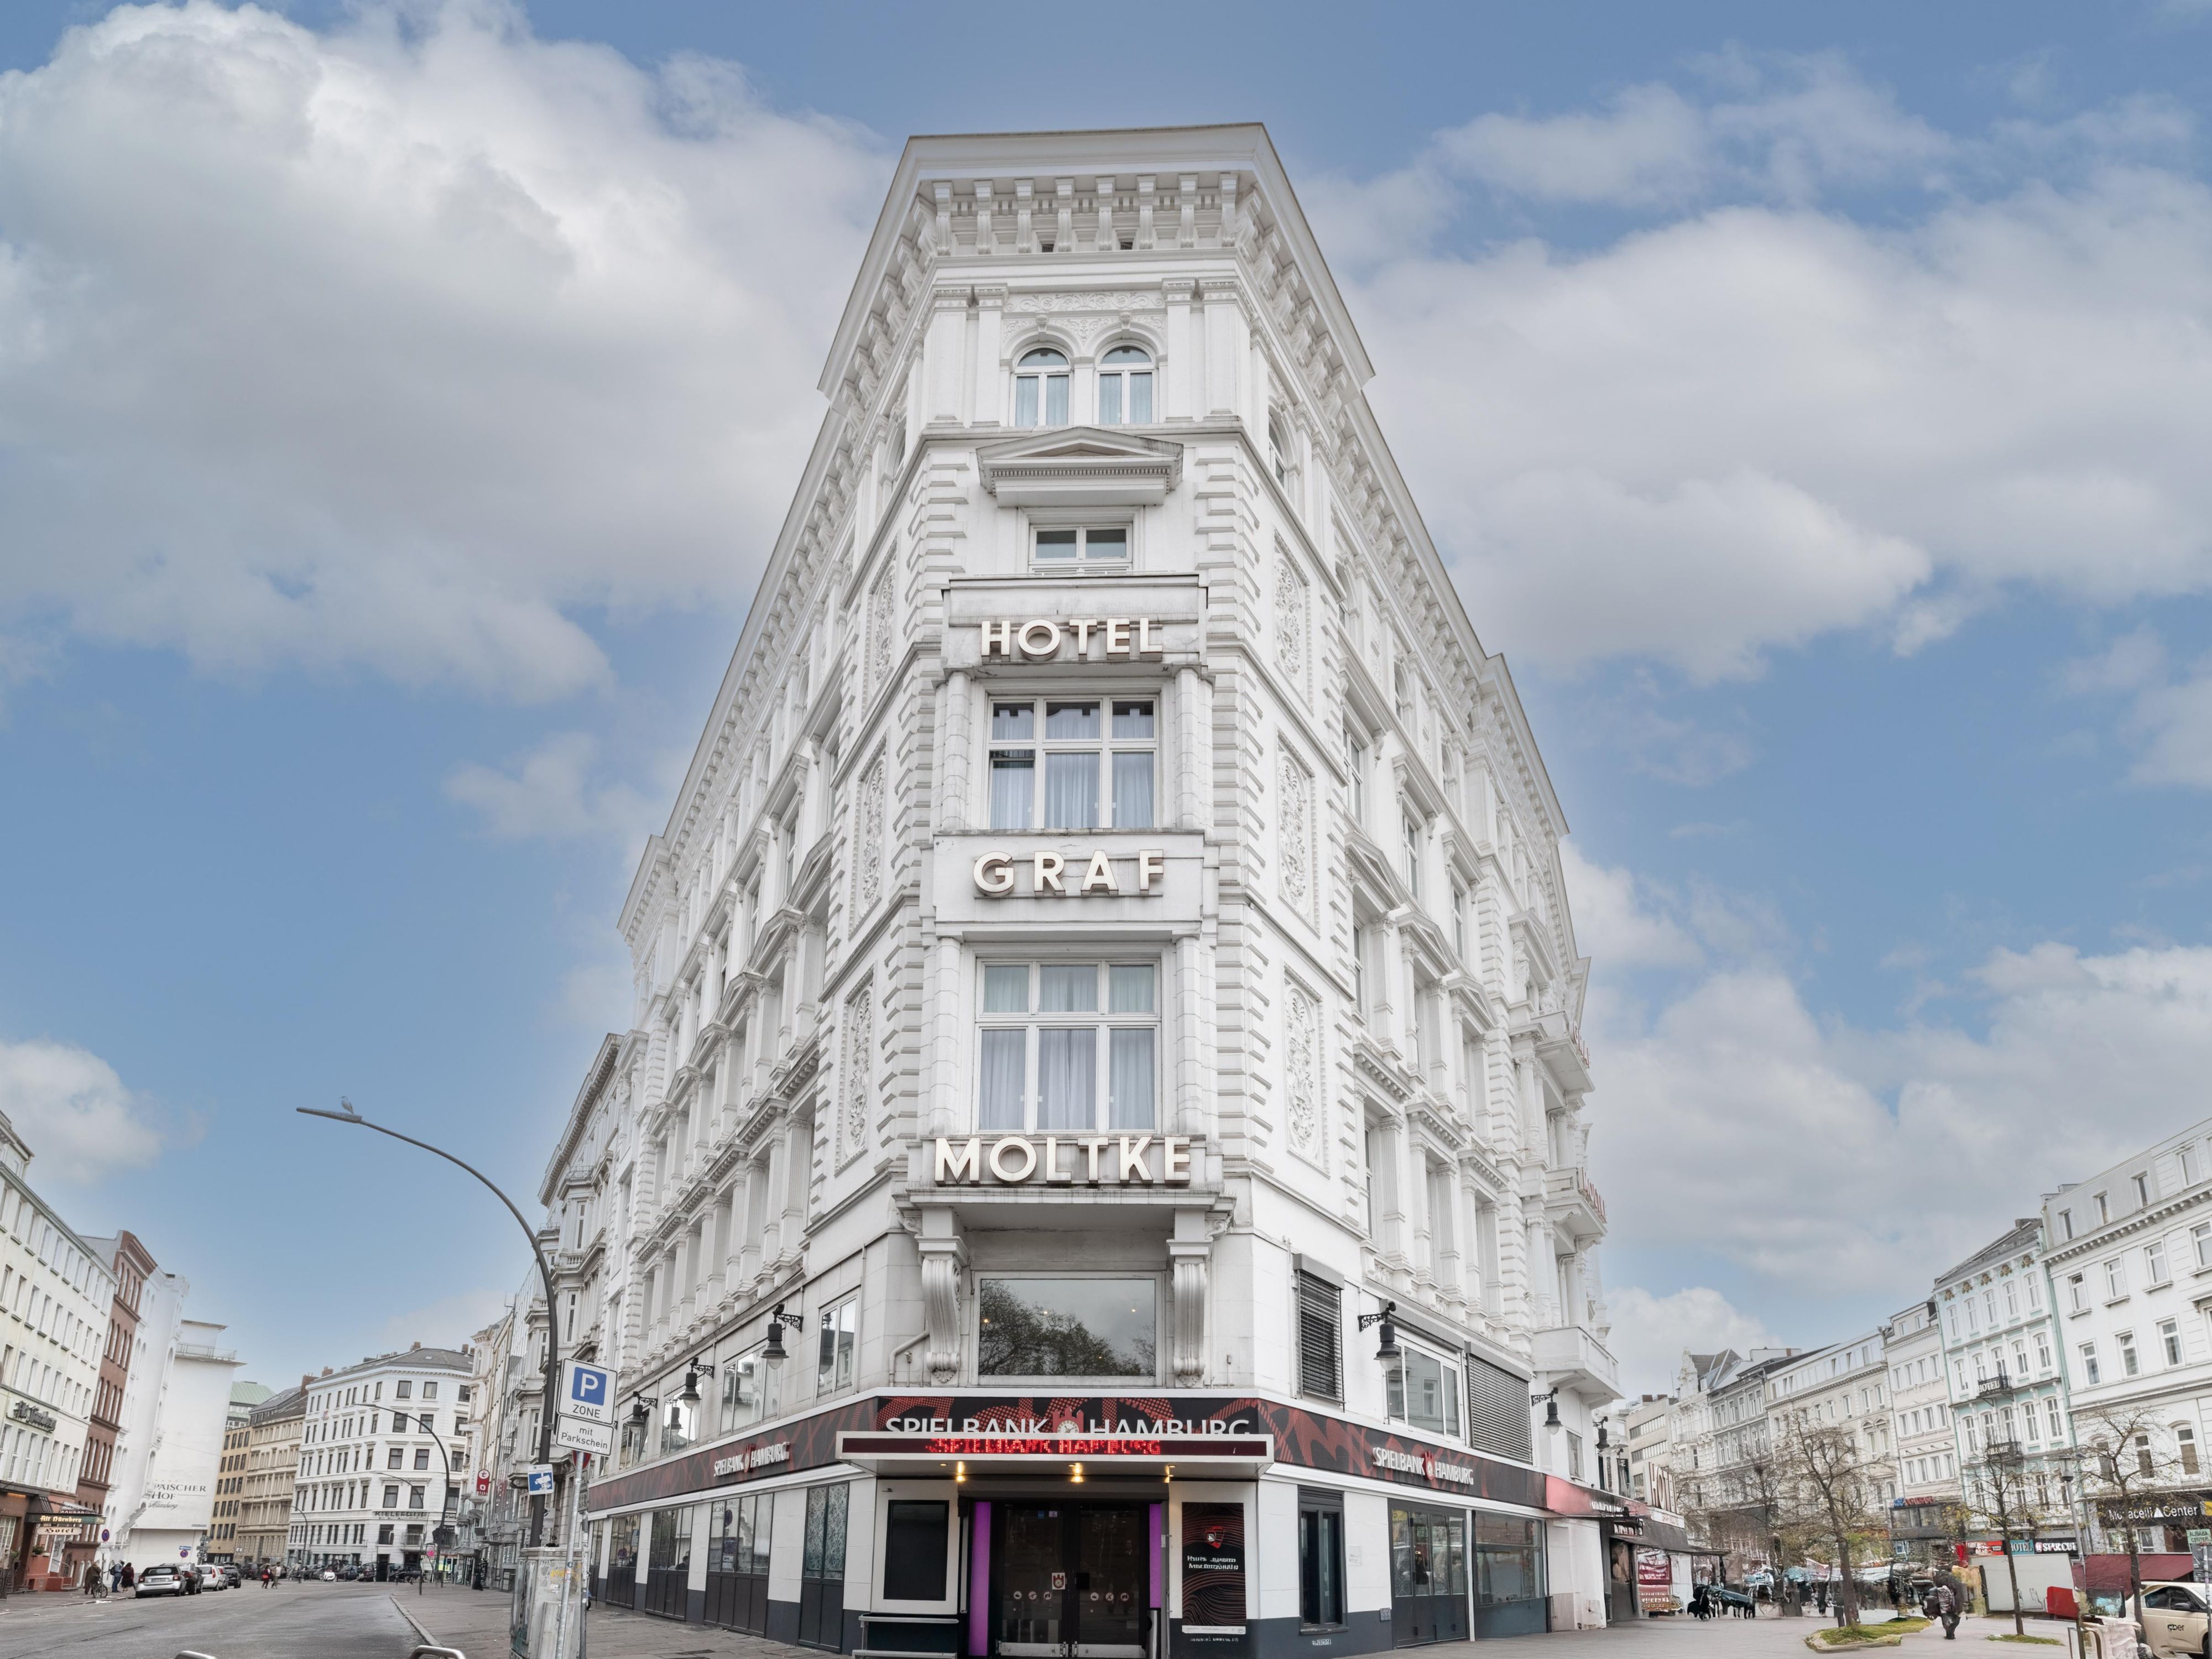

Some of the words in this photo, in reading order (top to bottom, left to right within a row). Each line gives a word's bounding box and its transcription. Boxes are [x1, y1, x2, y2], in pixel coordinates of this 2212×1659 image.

[980, 617, 1163, 662] HOTEL
[973, 849, 1164, 896] GRAF
[935, 1135, 1191, 1184] MOLTKE
[580, 1373, 599, 1397] P
[1978, 1381, 2000, 1393] HOTEL
[573, 1404, 601, 1418] ZONE
[580, 1427, 593, 1436] mit
[885, 1417, 1049, 1433] SPIELBANK
[1089, 1418, 1250, 1435] HAMBURG
[561, 1432, 608, 1449] Parkschein
[713, 1454, 744, 1477] SPIELBANK
[750, 1441, 790, 1468] HAMBURG
[1373, 1447, 1426, 1476] SPIELBANK
[1435, 1461, 1474, 1485] HAMBURG
[2163, 1506, 2198, 1517] Center
